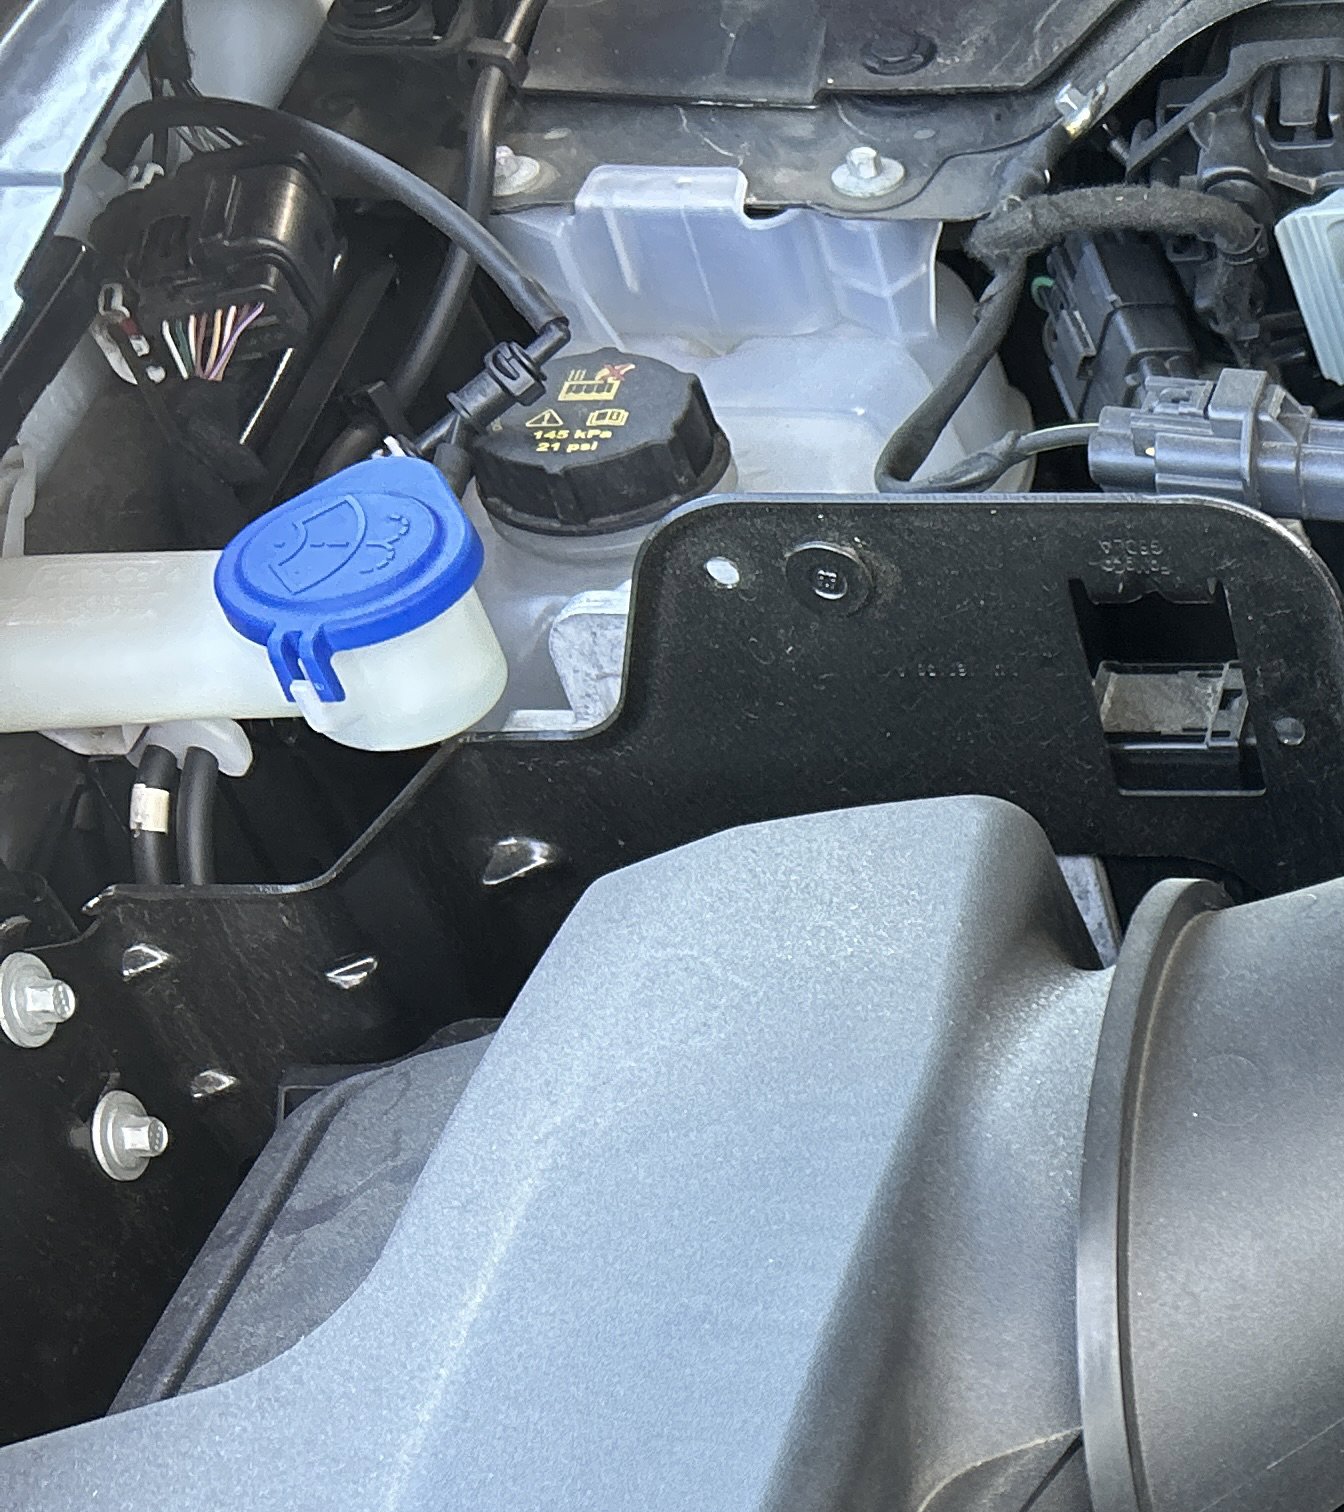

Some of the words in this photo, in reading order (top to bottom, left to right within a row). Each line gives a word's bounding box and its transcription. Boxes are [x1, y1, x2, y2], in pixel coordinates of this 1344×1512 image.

[533, 430, 570, 440] 145
[574, 429, 613, 439] kPa
[535, 442, 561, 452] 21
[566, 441, 598, 453] psi
